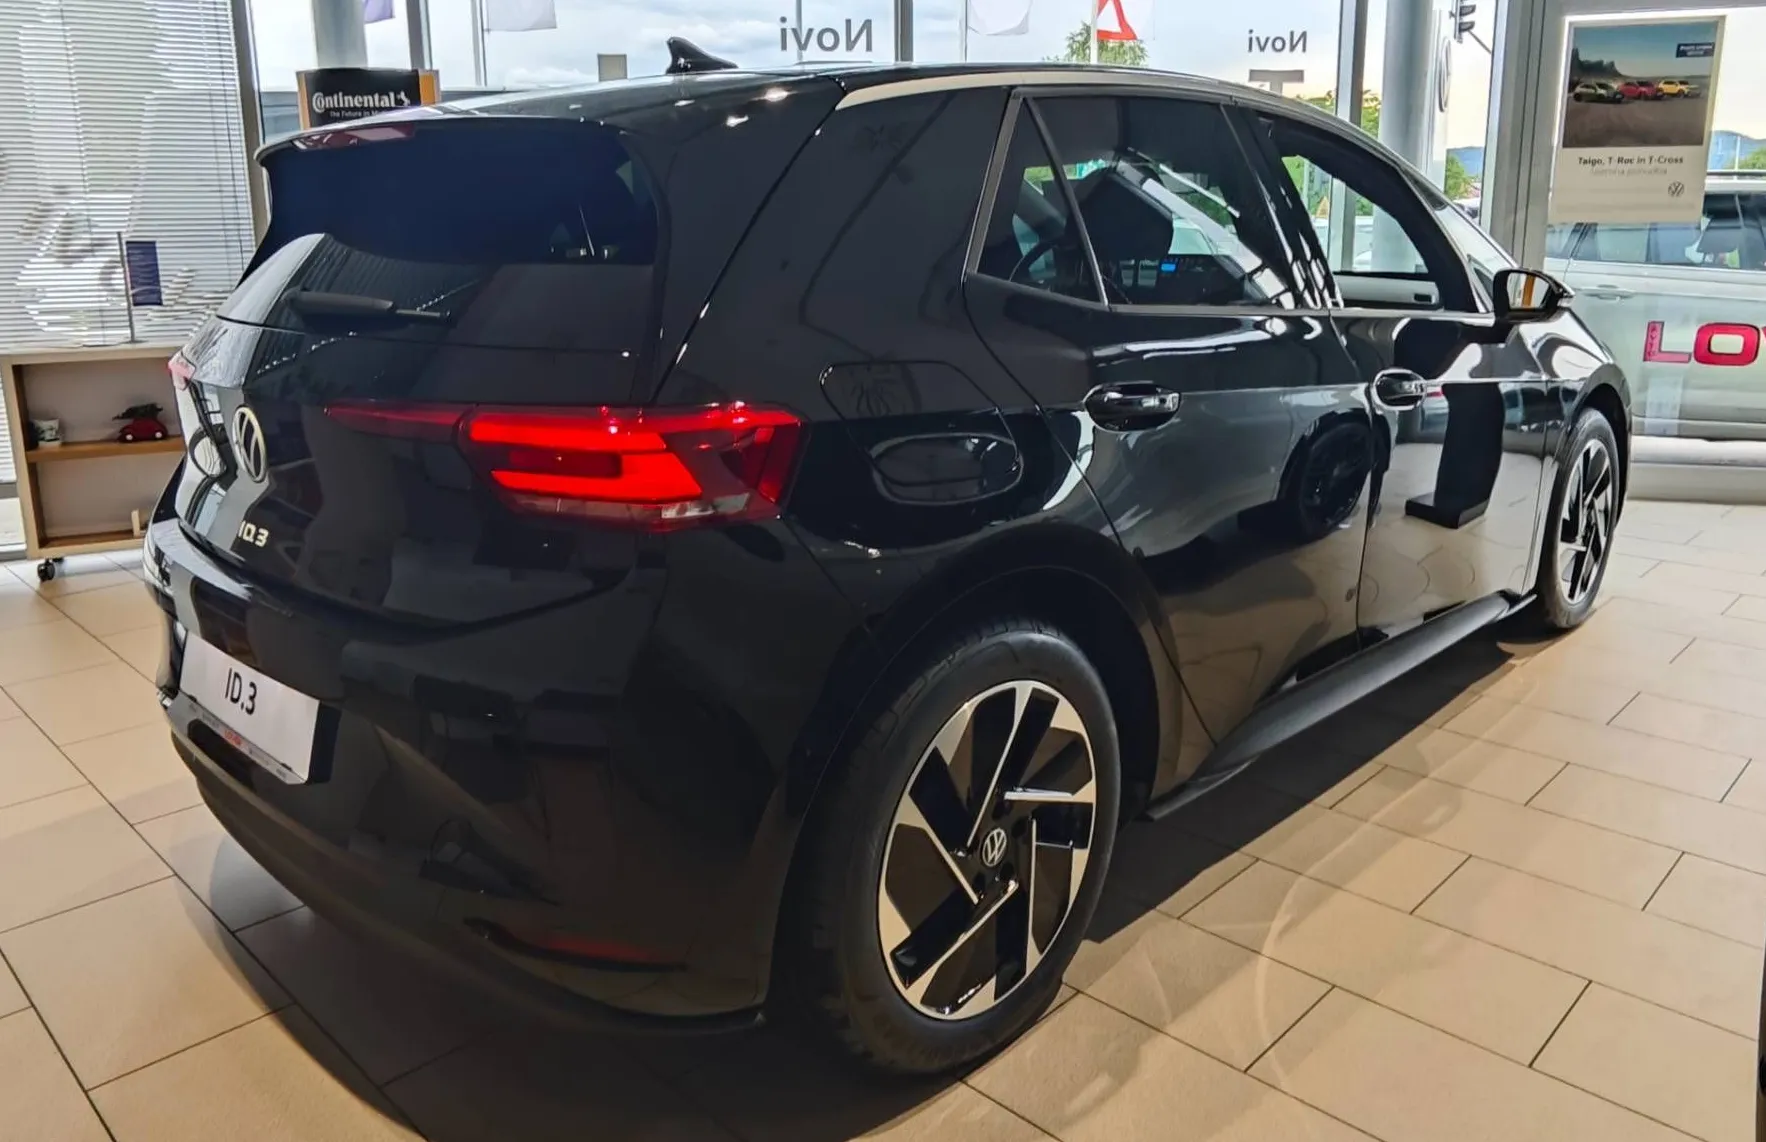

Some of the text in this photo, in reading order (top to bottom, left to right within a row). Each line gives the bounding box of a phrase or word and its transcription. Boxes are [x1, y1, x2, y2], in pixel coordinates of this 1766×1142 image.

[312, 91, 396, 113] Continental
[1578, 156, 1605, 167] Taigo,
[1636, 156, 1646, 164] in
[1643, 320, 1766, 366] LO
[225, 667, 257, 715] ID.3
